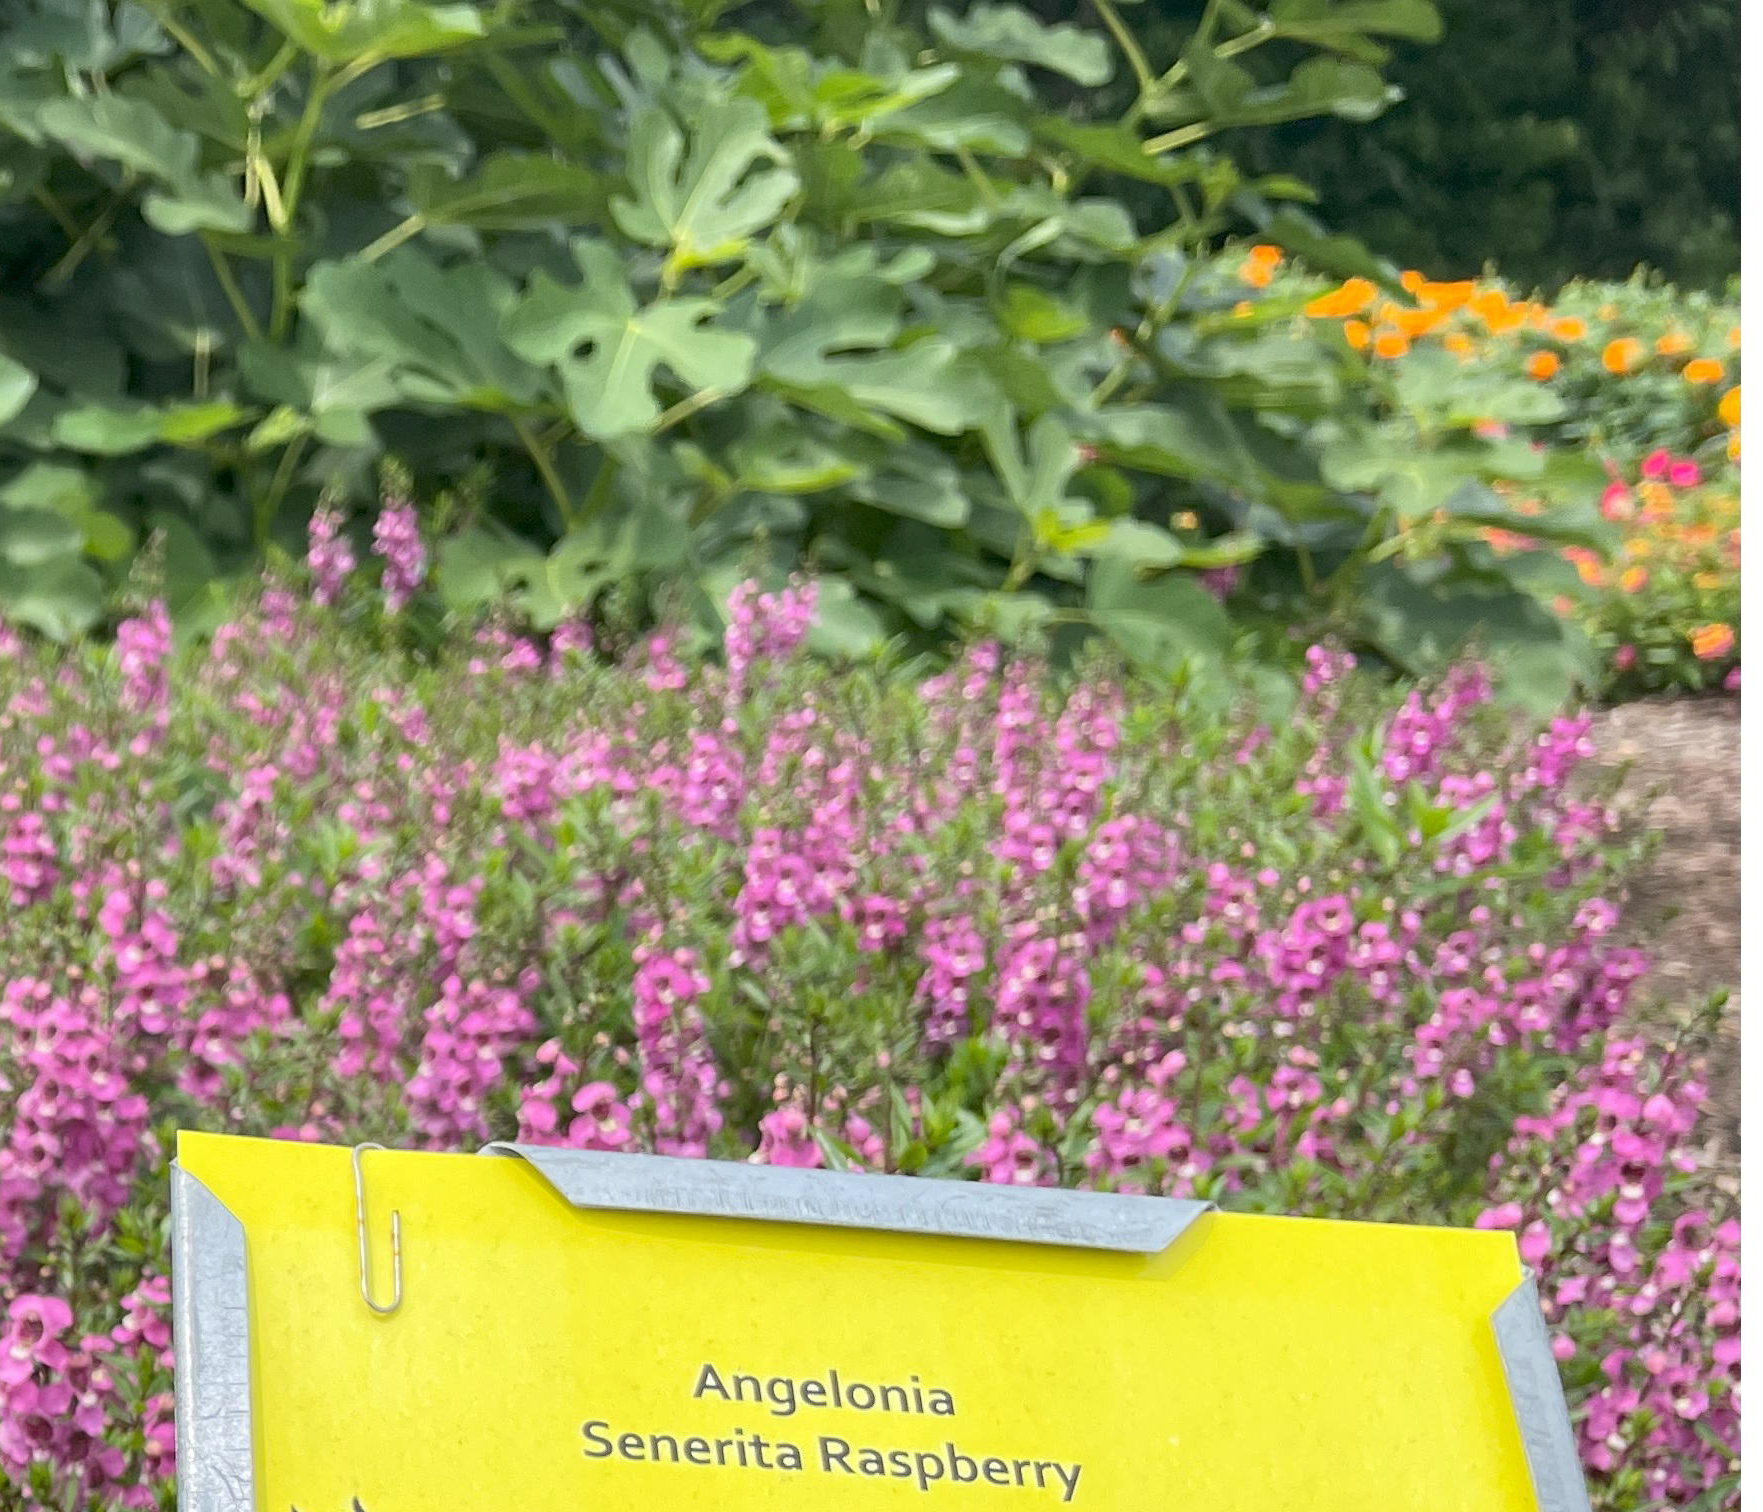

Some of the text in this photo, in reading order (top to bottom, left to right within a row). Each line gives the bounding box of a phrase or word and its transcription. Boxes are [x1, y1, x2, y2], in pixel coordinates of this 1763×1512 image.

[692, 1363, 956, 1416] Angelonia
[581, 1420, 1082, 1502] Senerita Raspberry
